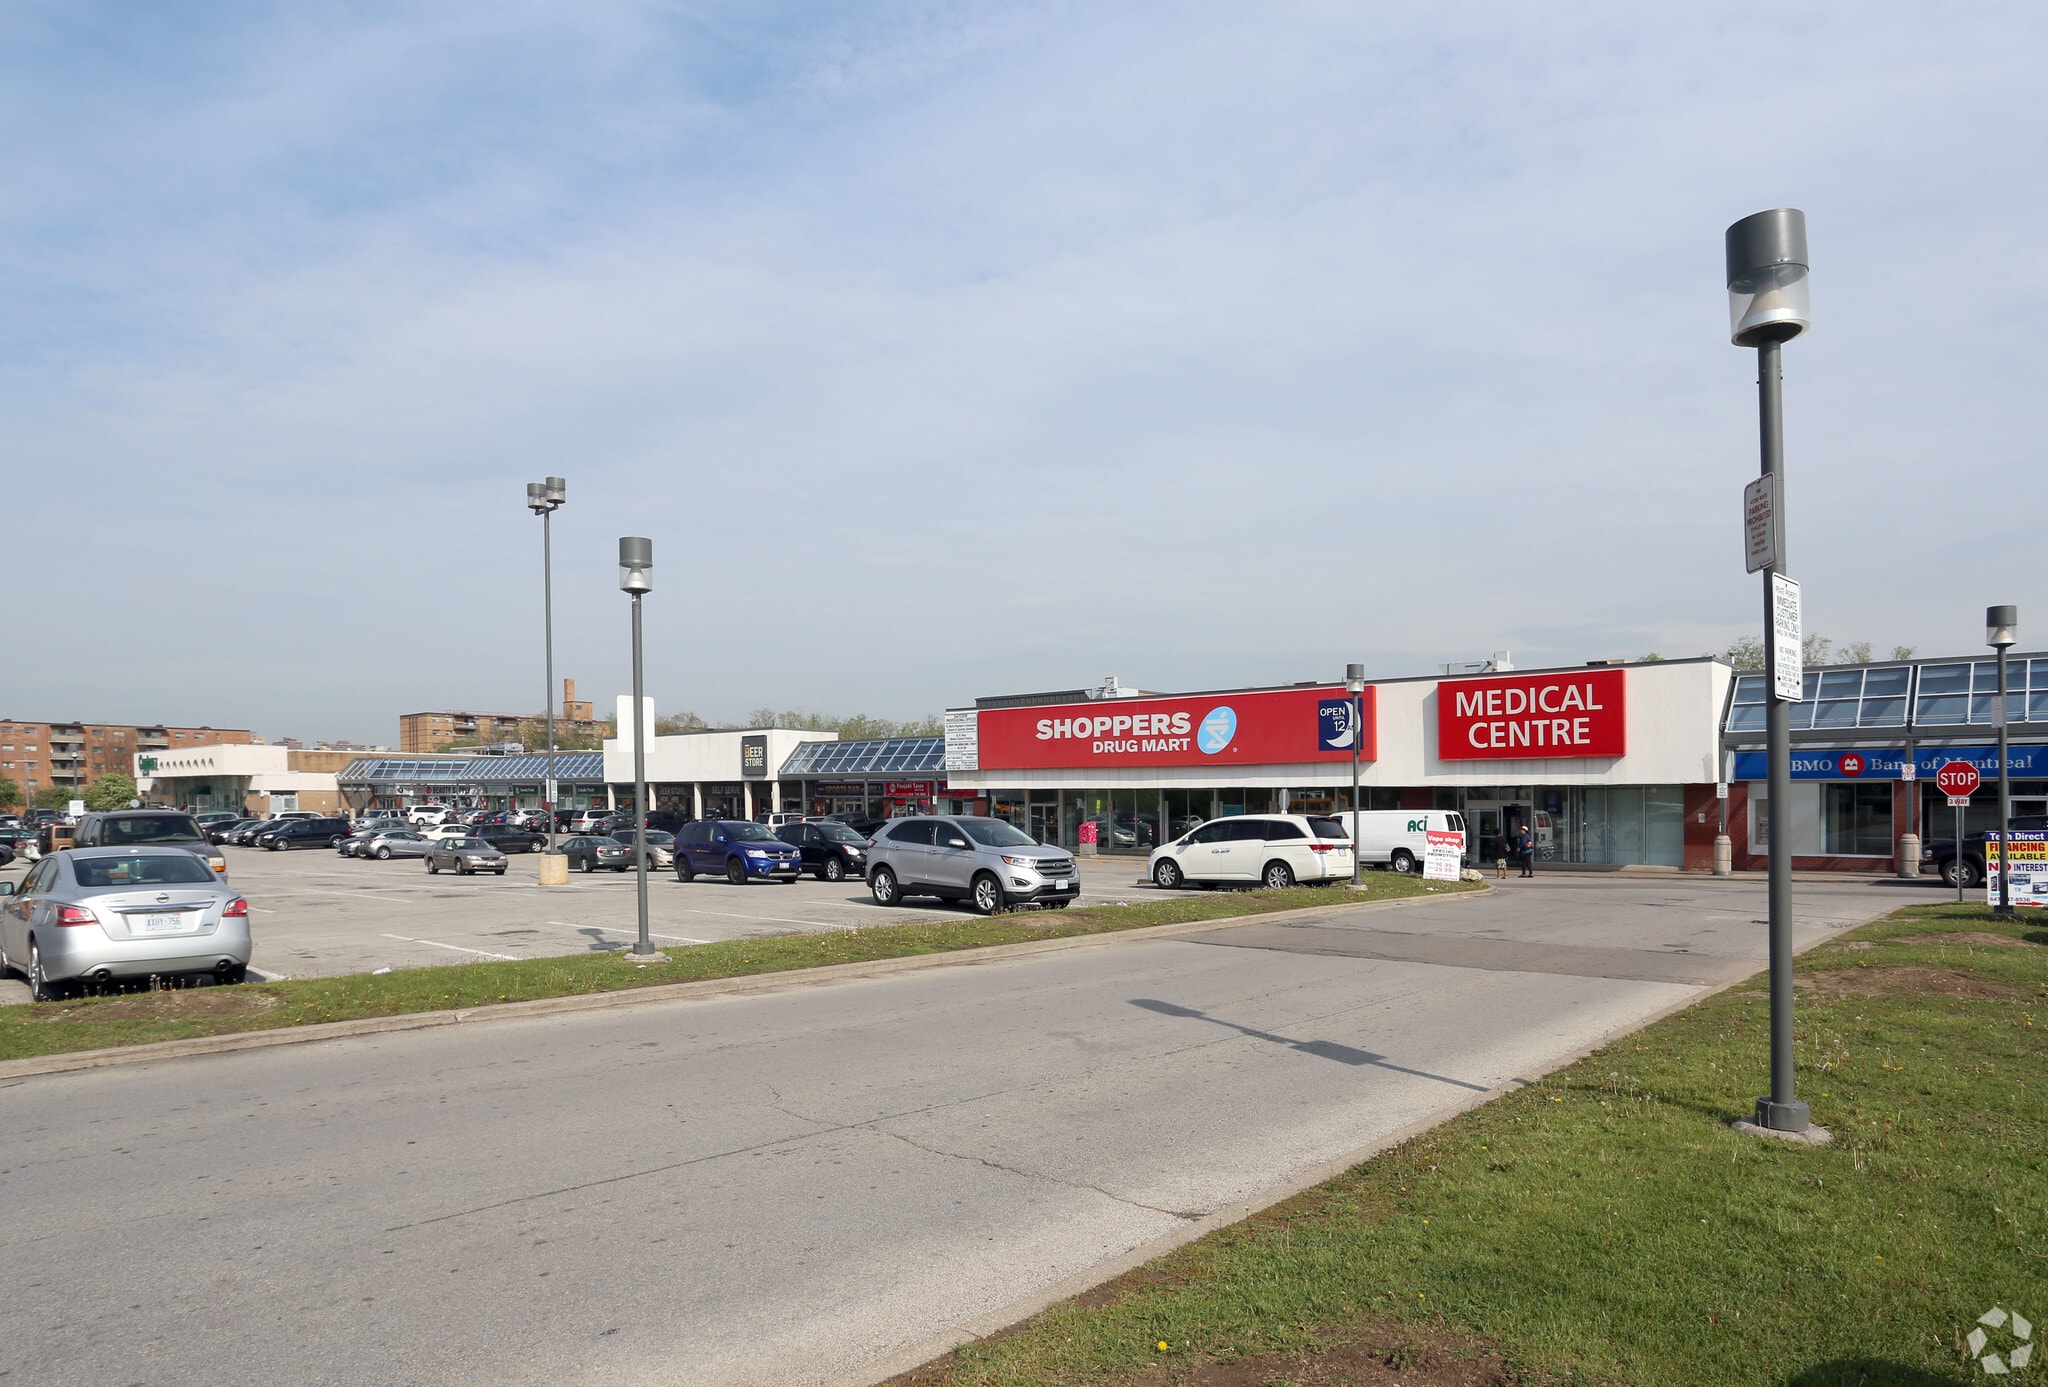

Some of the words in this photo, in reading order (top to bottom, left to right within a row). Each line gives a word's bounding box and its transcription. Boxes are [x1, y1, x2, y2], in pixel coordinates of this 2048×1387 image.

[1748, 500, 1769, 516] PARKING
[1747, 509, 1771, 527] PROHIBITED
[1776, 595, 1797, 612] IMMEDIATE
[1776, 606, 1798, 622] CUSTOMER
[1775, 617, 1790, 631] PARKING
[1790, 622, 1799, 634] ONLY
[1456, 684, 1603, 718] MEDICAL
[1319, 707, 1346, 717] OPEN
[1035, 711, 1191, 740] SHOPPERS
[1334, 720, 1346, 732] 12
[1468, 717, 1590, 749] CENTRE
[744, 744, 763, 758] BEER
[1092, 739, 1138, 753] DRUG
[1141, 737, 1191, 752] MART
[744, 757, 764, 767] STORE
[1791, 759, 1833, 772] BMO
[1871, 758, 1917, 771] Ban
[1921, 757, 1940, 770] of
[1940, 772, 1977, 786] STOP
[433, 786, 451, 794] BEAUTY
[711, 786, 724, 794] SELF
[724, 786, 741, 794] SERVE
[1444, 836, 1460, 844] shop
[1989, 832, 2012, 841] Teh
[2015, 832, 2045, 841] Direct
[1989, 842, 2045, 852] FIANCING
[2014, 863, 2048, 872] INTEREST
[168, 917, 181, 925] 756
